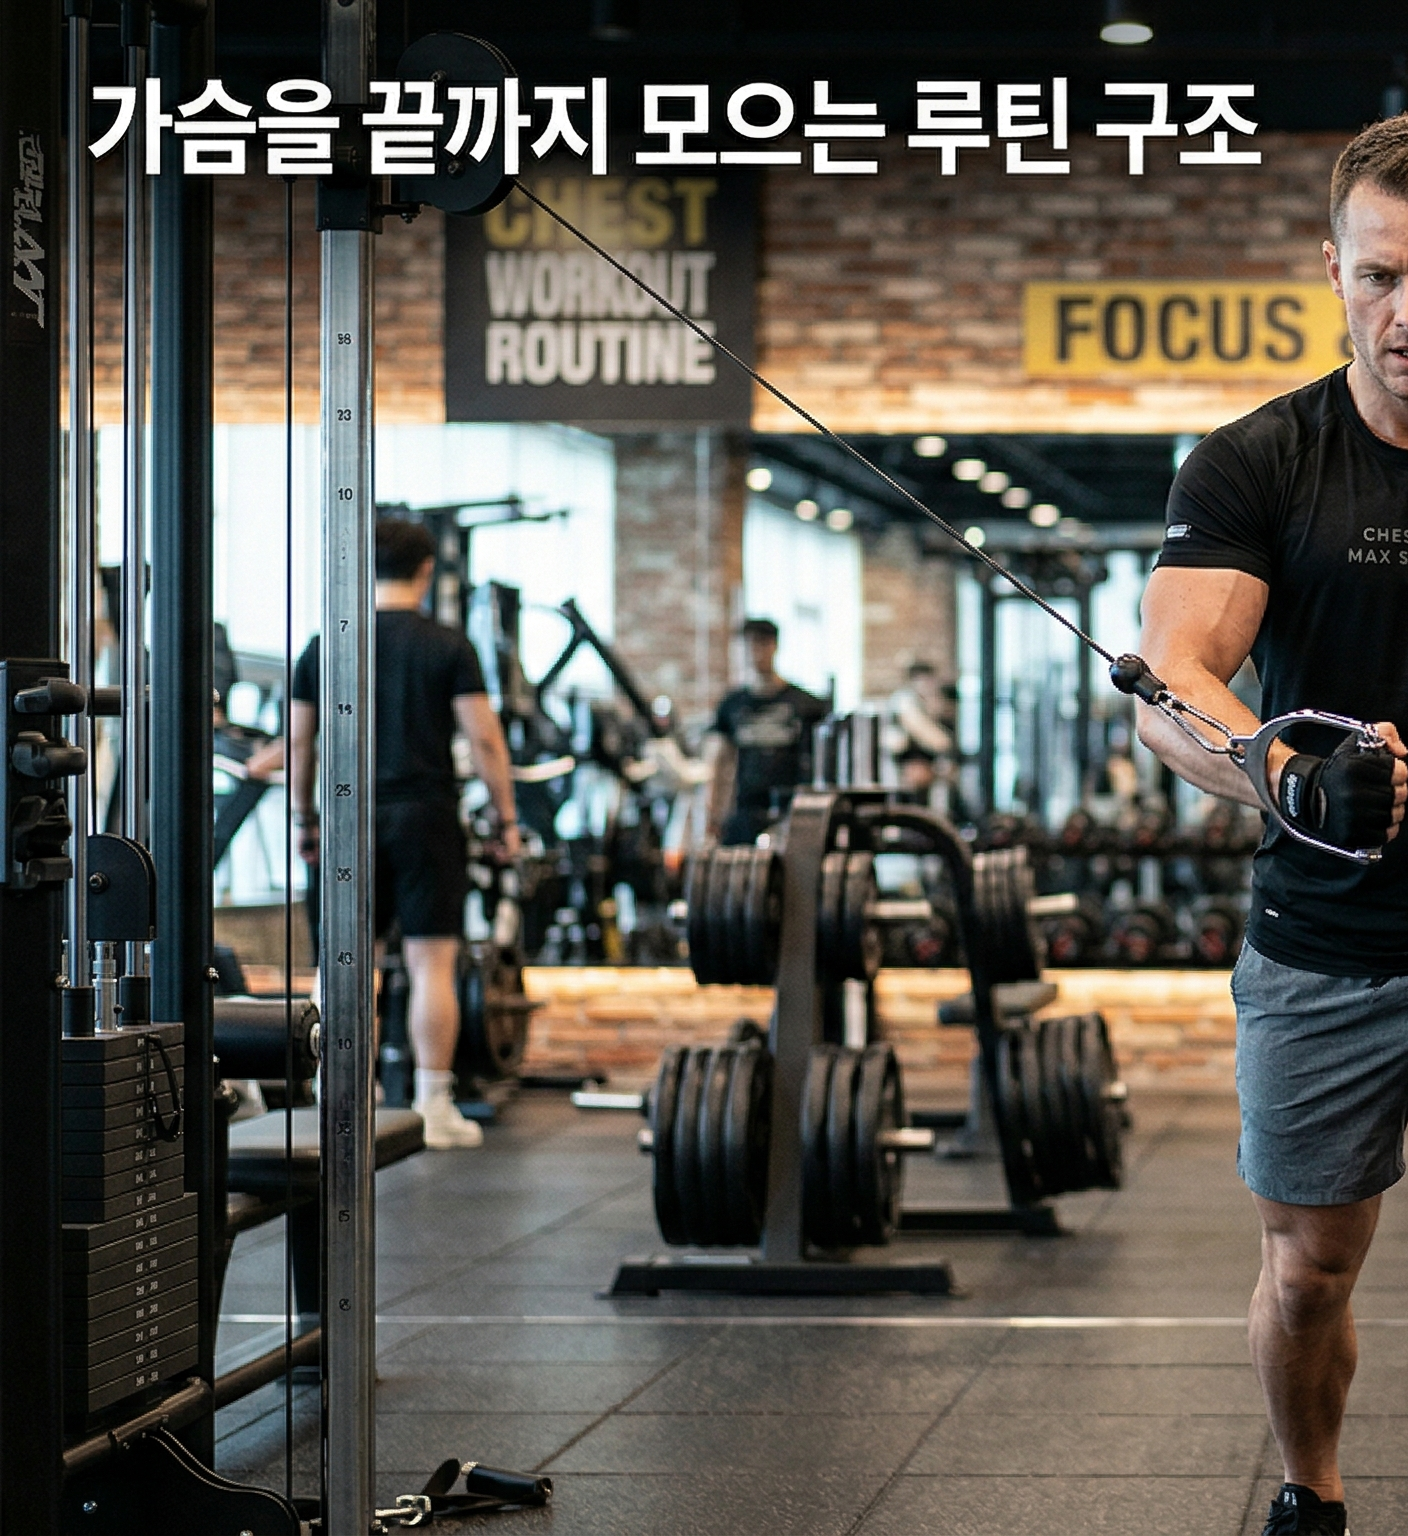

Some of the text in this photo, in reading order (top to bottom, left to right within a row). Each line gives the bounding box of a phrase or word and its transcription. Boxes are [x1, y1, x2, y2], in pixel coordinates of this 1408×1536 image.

[484, 177, 718, 248] CHEST
[485, 251, 717, 319] WORKOUT
[485, 320, 717, 387] ROUTINE
[1057, 293, 1303, 363] FOCUS
[338, 487, 352, 501] 10
[1348, 547, 1391, 565] MAX
